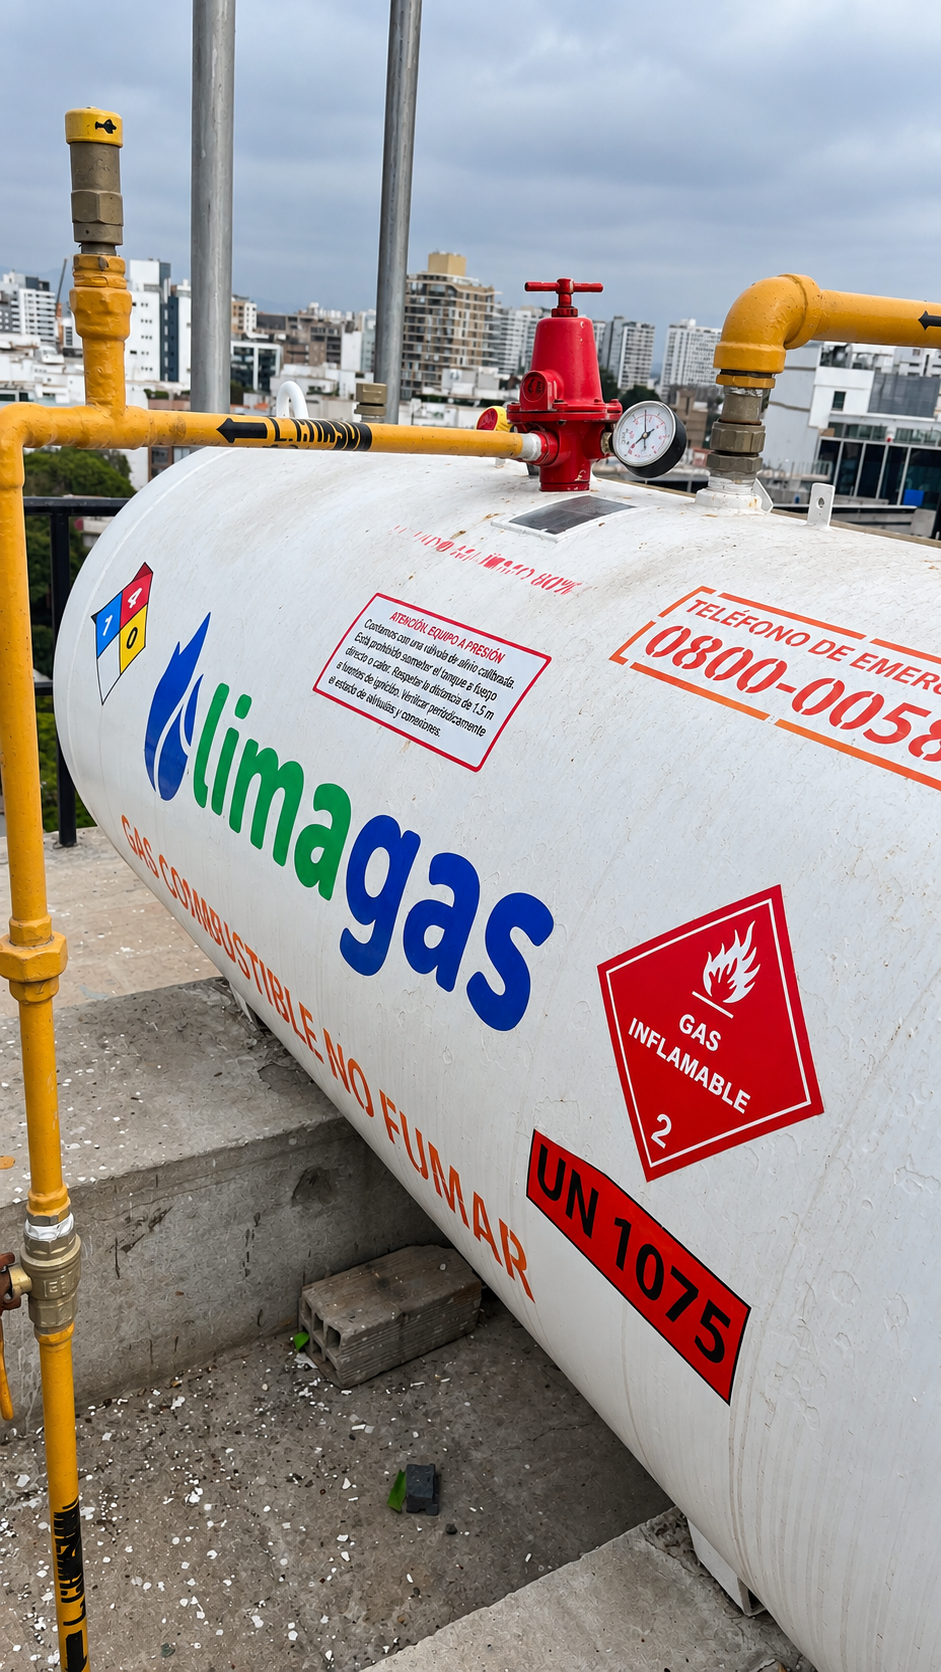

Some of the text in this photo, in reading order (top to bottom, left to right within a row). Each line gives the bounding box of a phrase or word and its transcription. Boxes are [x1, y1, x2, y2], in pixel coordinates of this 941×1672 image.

[128, 587, 143, 609] 4
[102, 614, 114, 637] 1
[126, 626, 139, 650] 0
[685, 599, 811, 647] TELÉFONO
[808, 639, 856, 662] DE
[458, 639, 466, 648] A
[465, 641, 505, 663] PRESIÓN
[484, 710, 494, 720] m
[193, 682, 554, 1032] limagas
[678, 1013, 722, 1052] GAS
[121, 814, 160, 879] GAS
[323, 1026, 375, 1118] NO
[379, 1088, 536, 1304] FUMAR
[628, 1017, 751, 1114] INFLAMABLE
[650, 1113, 672, 1149] 2
[536, 1143, 733, 1364] UN 1075
